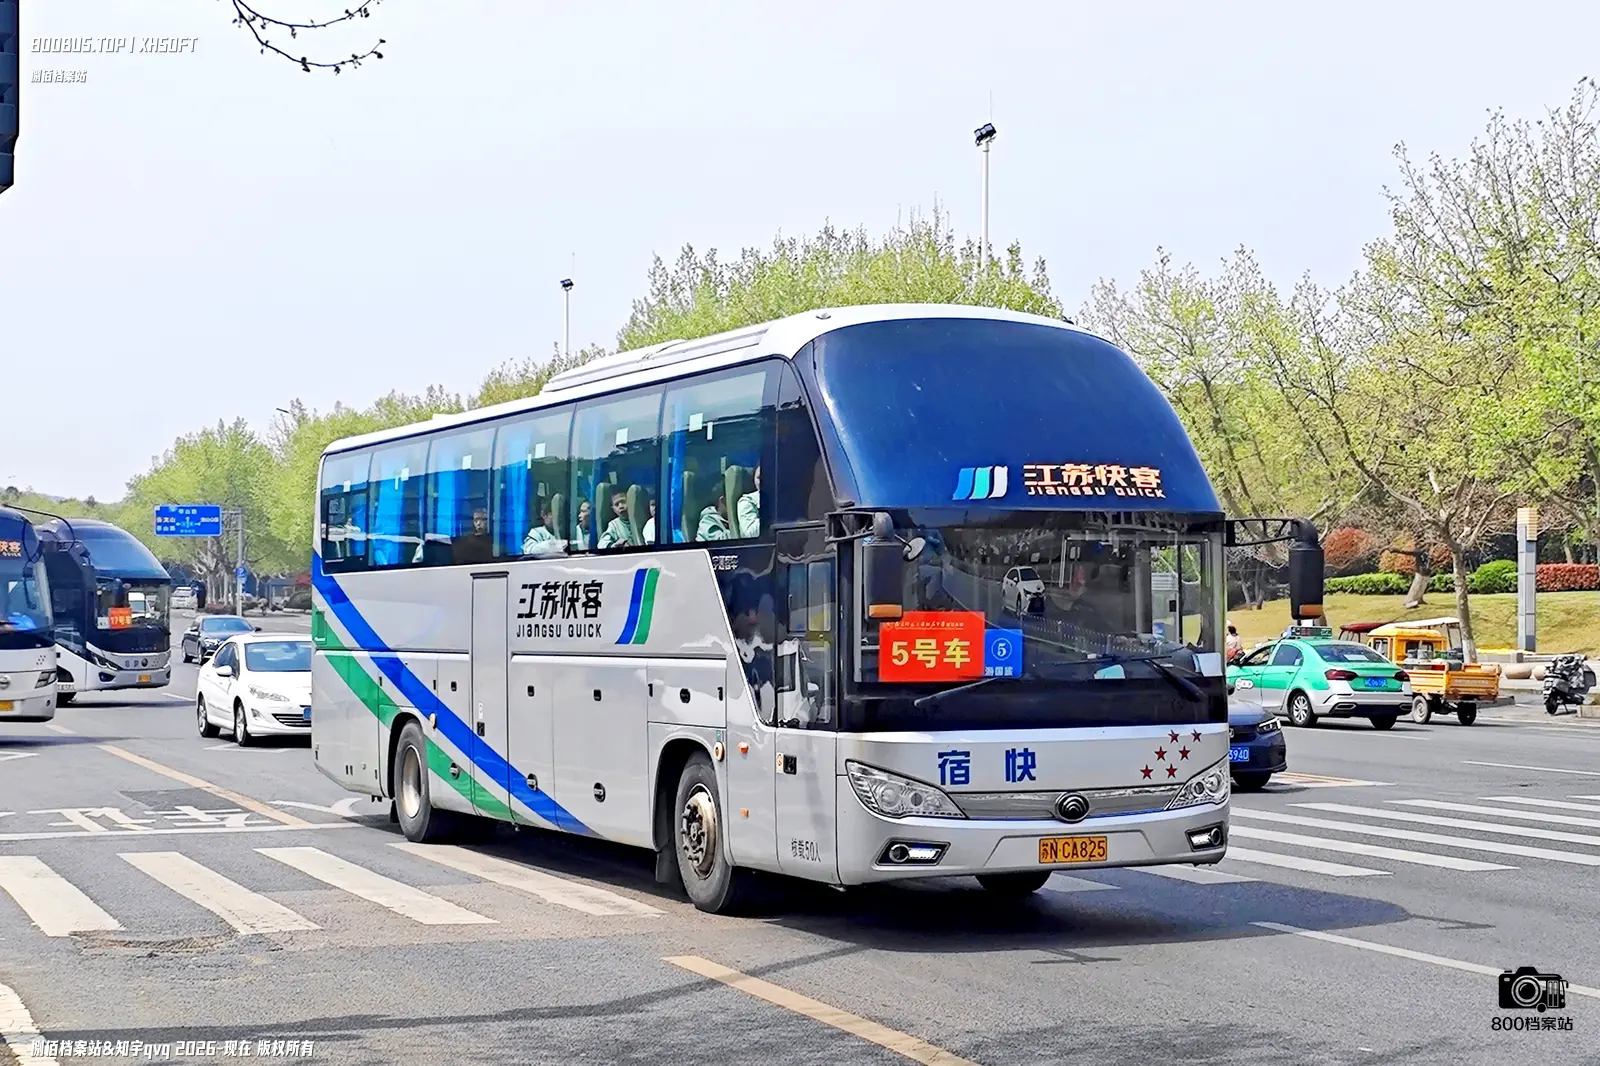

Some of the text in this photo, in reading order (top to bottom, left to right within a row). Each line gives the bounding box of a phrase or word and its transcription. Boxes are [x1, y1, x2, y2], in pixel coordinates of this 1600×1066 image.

[1023, 463, 1162, 488] 江苏快客
[517, 580, 604, 619] 江苏快客
[568, 623, 602, 638] QUICK
[892, 638, 971, 668] 5号车
